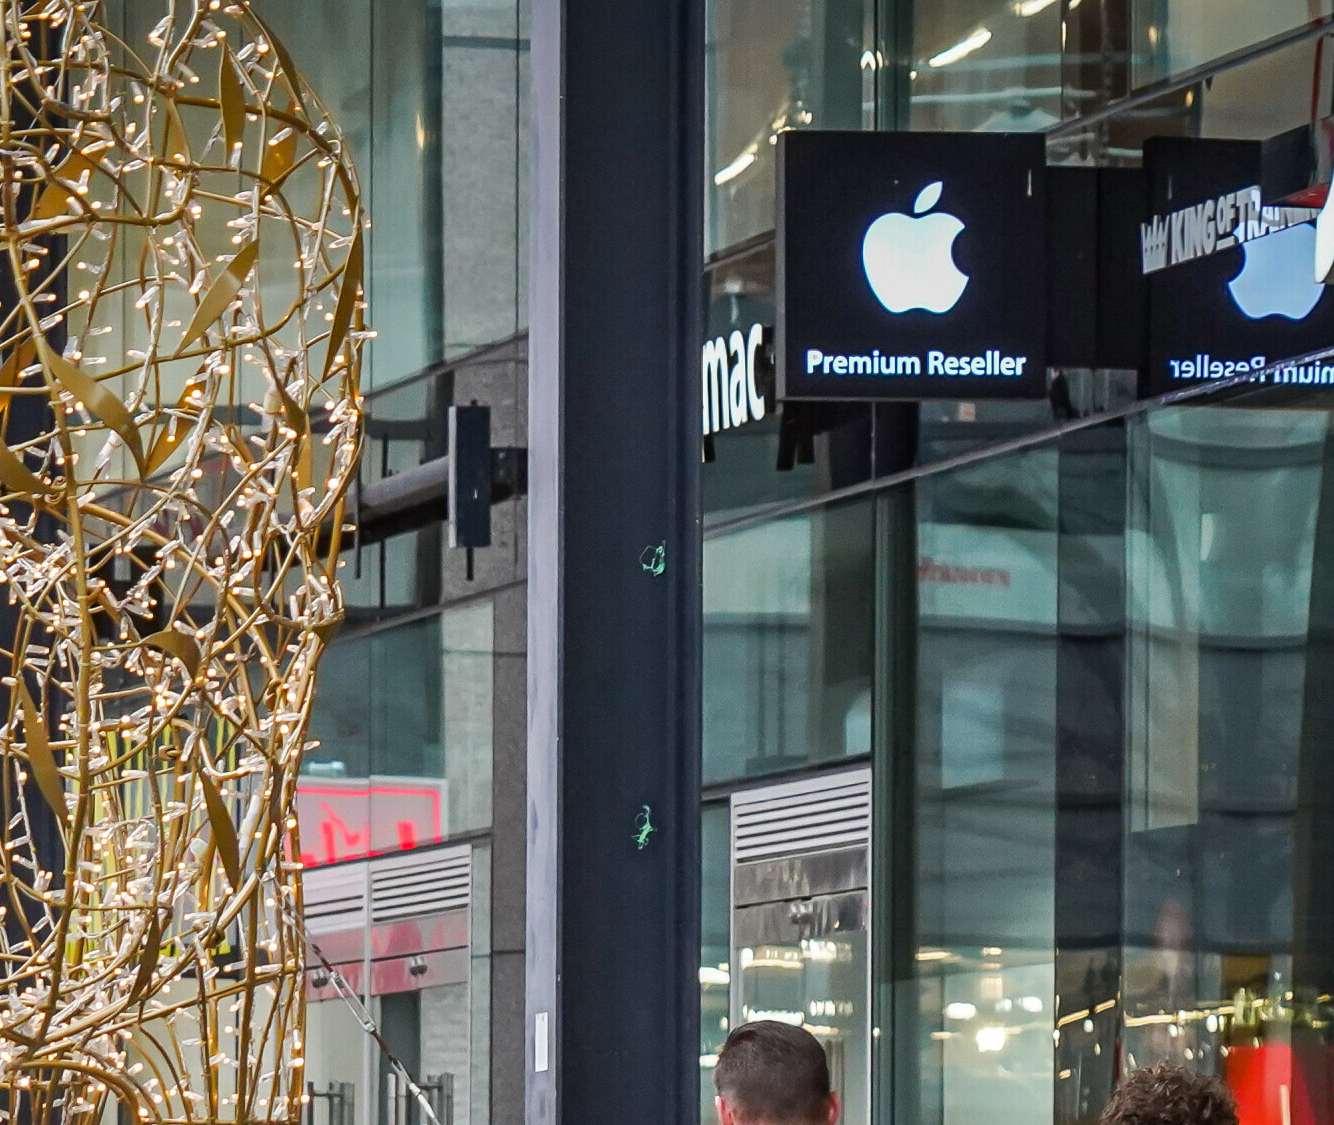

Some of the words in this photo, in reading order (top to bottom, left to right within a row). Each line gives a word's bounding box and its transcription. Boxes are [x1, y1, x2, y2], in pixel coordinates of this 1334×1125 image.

[1171, 199, 1216, 265] KING
[1217, 192, 1237, 236] OF
[806, 350, 921, 376] Premium
[927, 350, 1027, 376] Reseller
